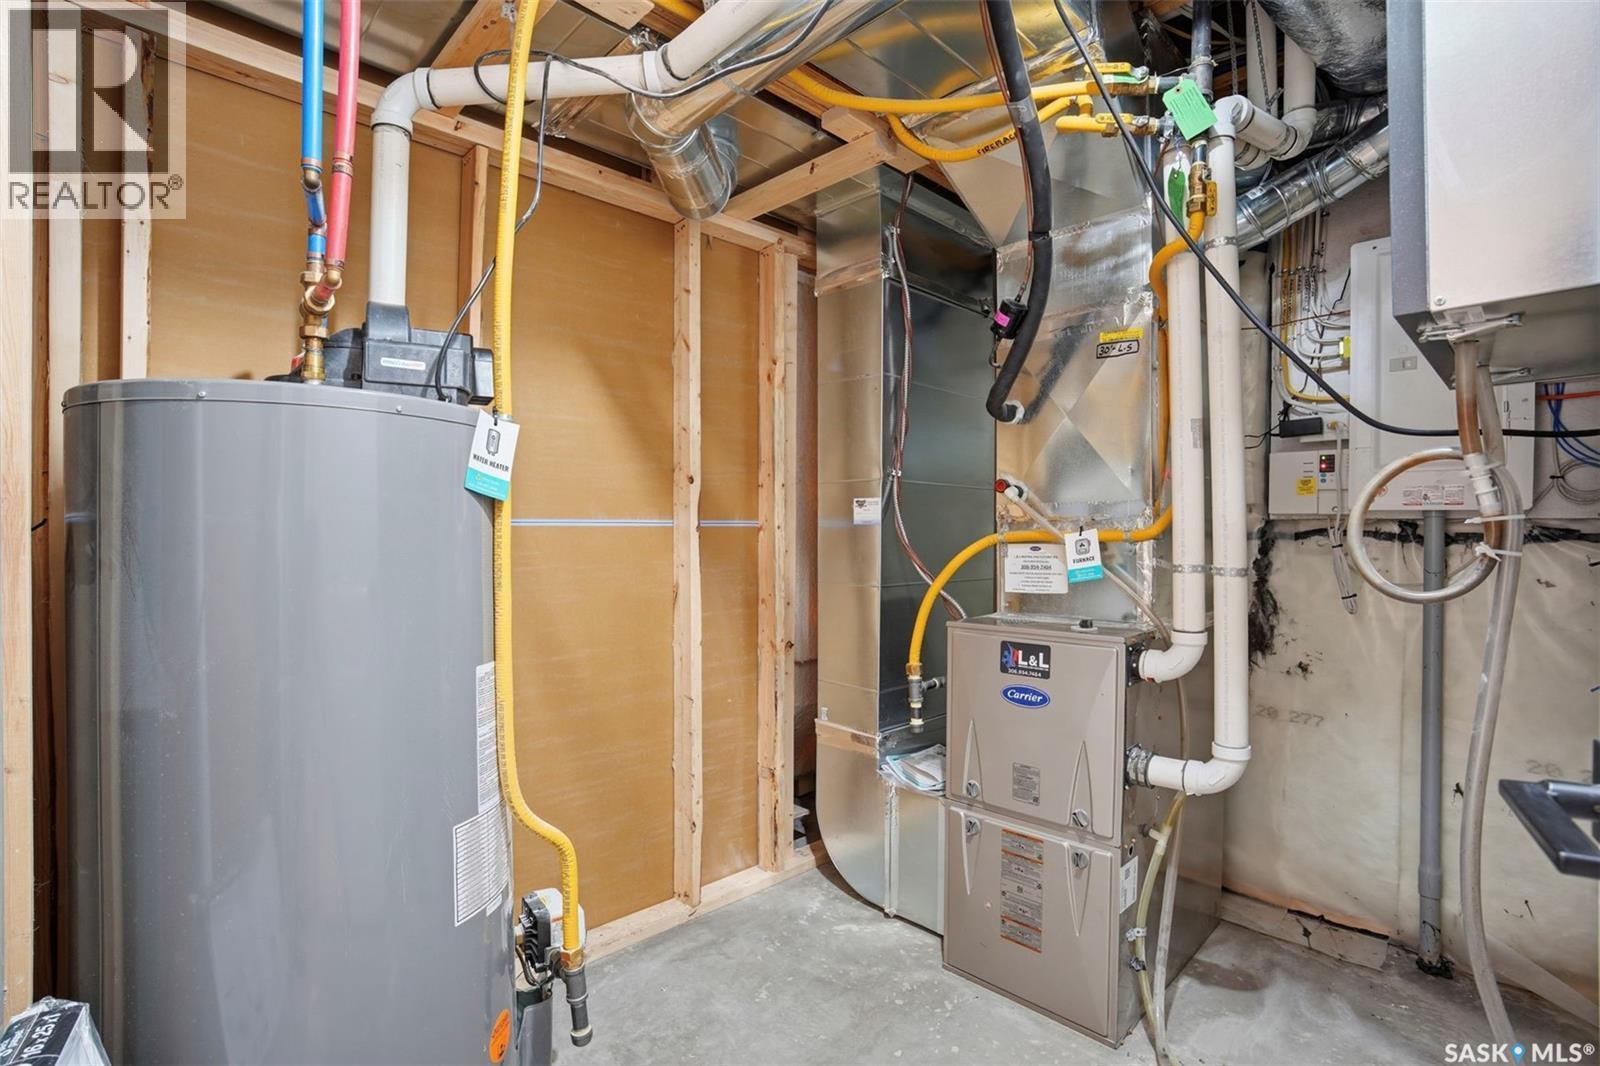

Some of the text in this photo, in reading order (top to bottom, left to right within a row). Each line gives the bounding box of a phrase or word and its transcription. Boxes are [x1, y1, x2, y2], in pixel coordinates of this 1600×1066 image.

[473, 454, 510, 472] WATER HEATER
[1072, 556, 1095, 564] FURNACE
[1018, 649, 1049, 669] L&L
[1007, 688, 1043, 703] Carrier
[1288, 710, 1325, 727] 277
